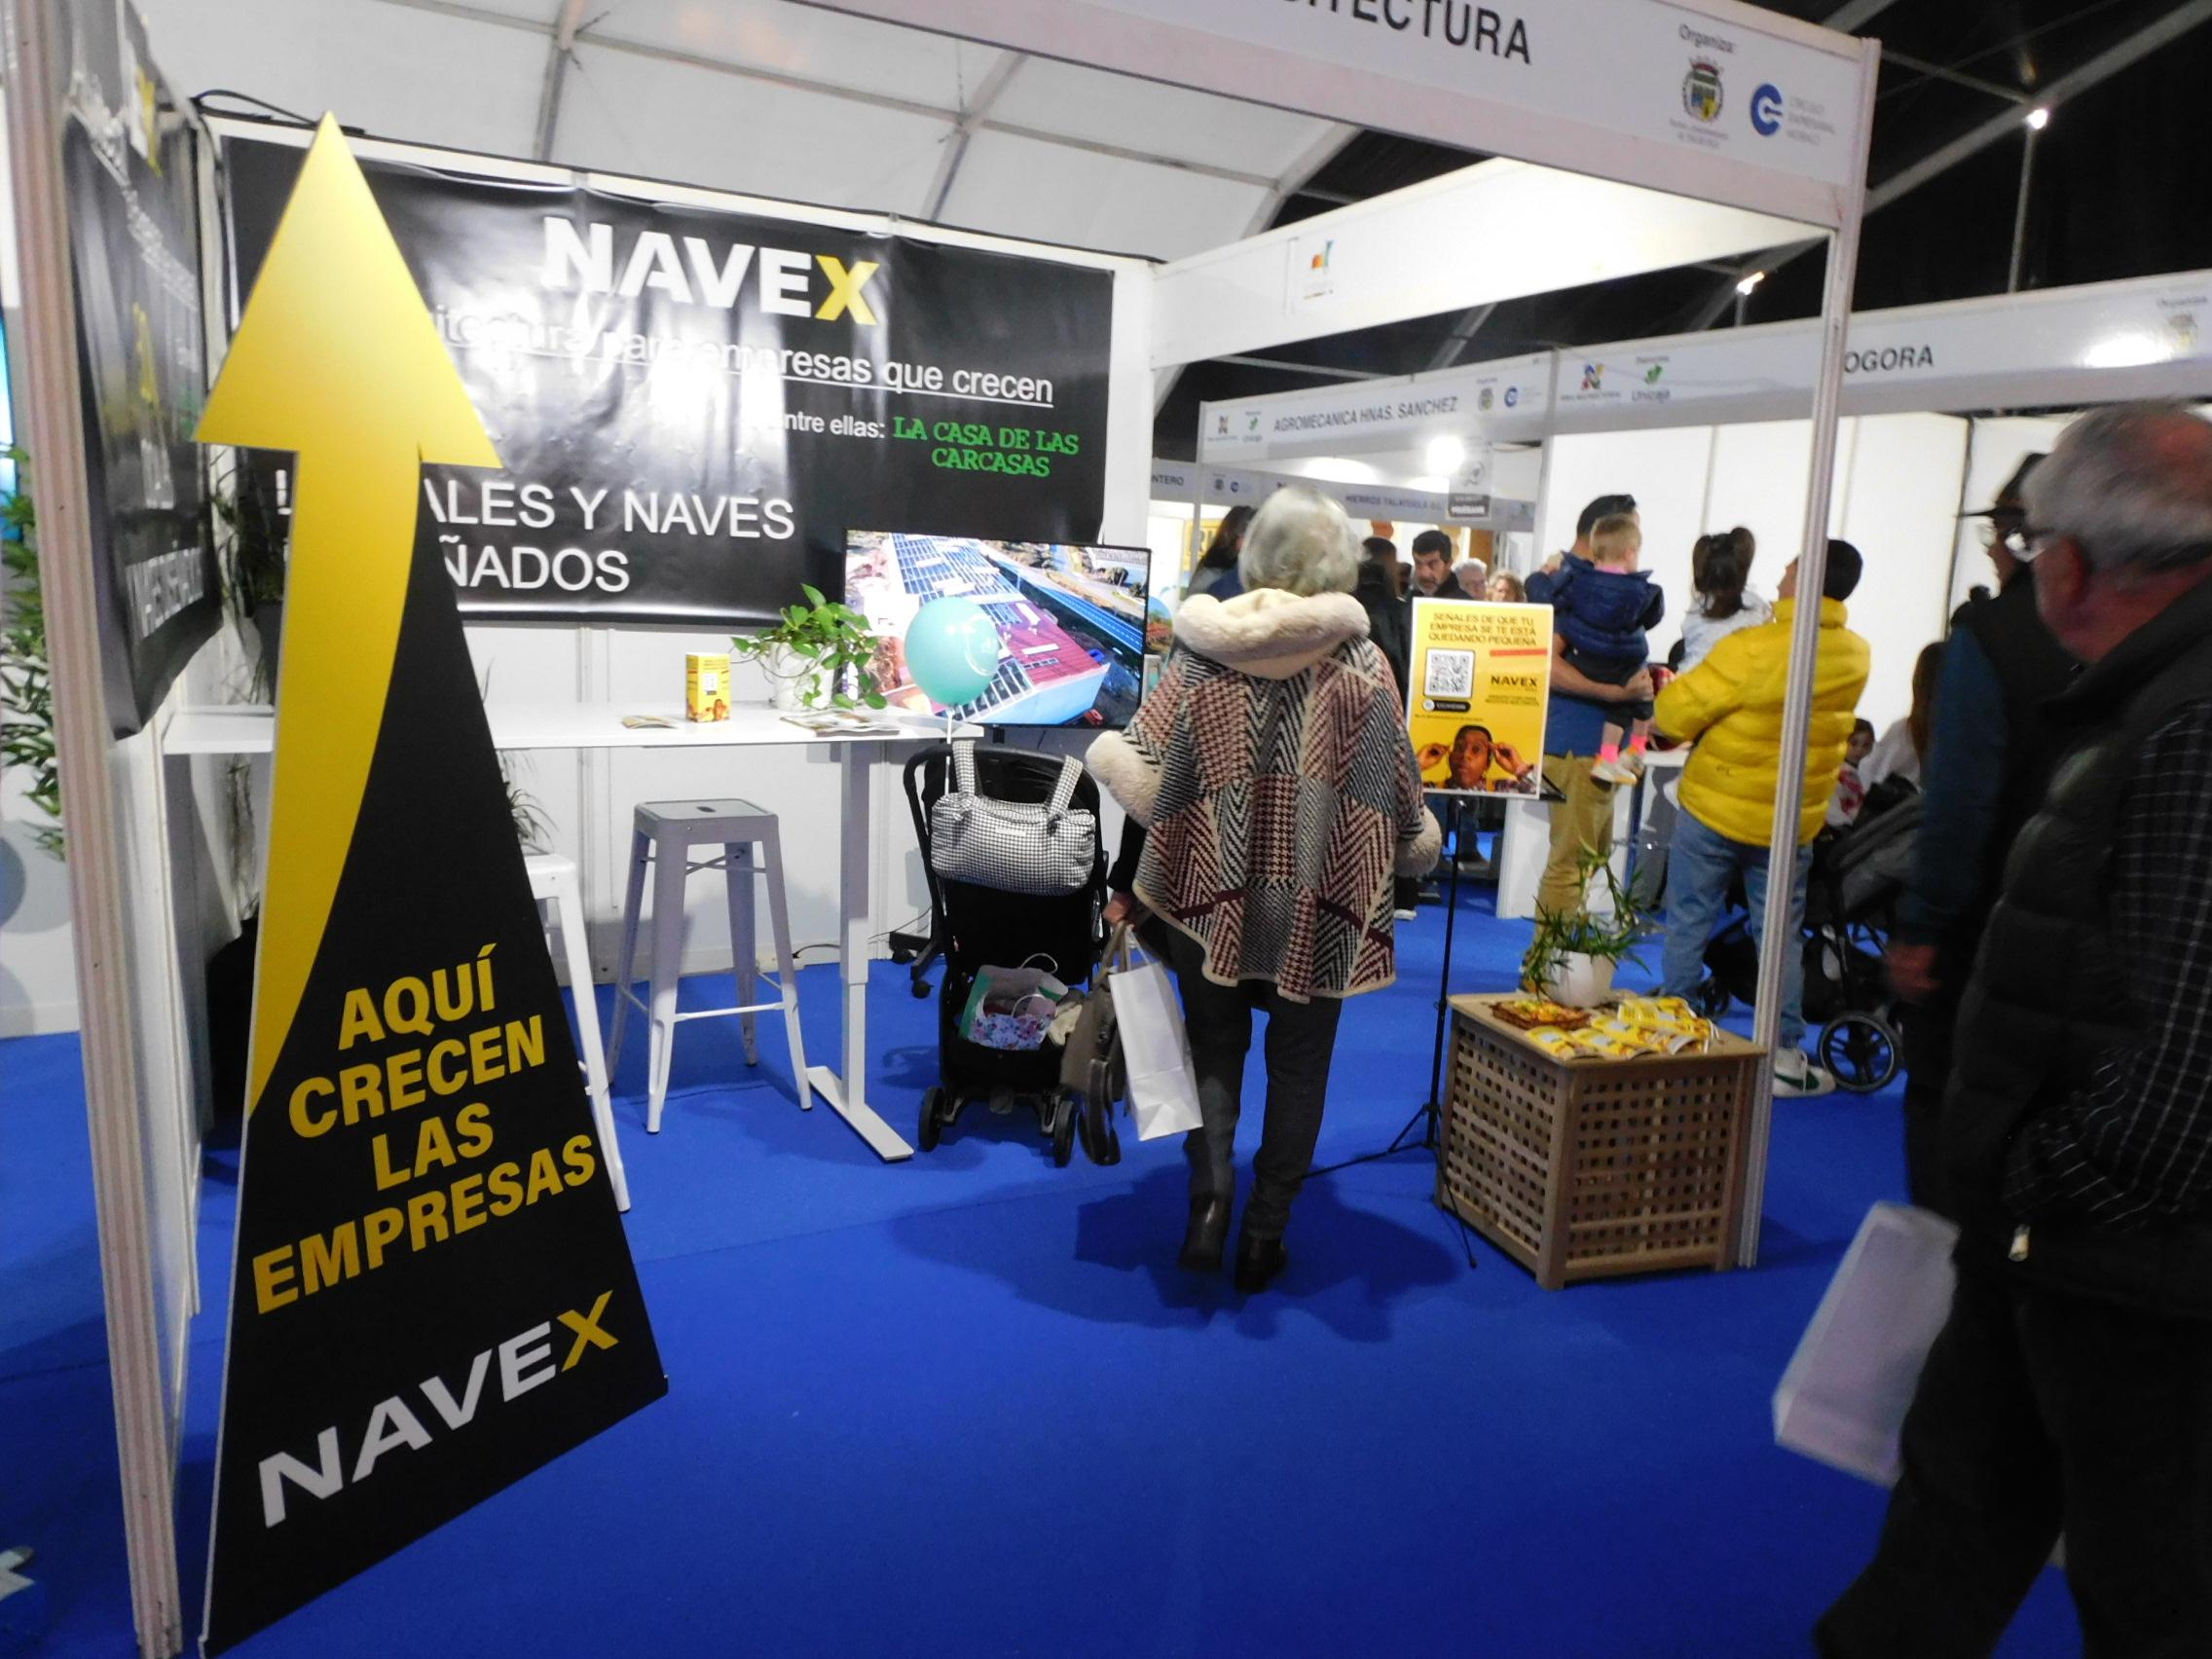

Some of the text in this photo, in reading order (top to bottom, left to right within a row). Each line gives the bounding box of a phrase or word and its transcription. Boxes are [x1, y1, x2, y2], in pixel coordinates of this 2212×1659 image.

[1283, 0, 1530, 65] ECTURA
[541, 216, 880, 326] NAVEX
[884, 359, 943, 393] que
[951, 368, 1053, 403] crecen
[1844, 344, 1934, 374] OGORA
[777, 411, 1080, 455] ntre ellas: LA CASA DE LAS
[1272, 409, 1357, 433] AGROMECANICA
[1397, 395, 1458, 420] SANCHEZ
[931, 448, 1051, 477] CARCASAS
[570, 487, 608, 531] Y
[623, 490, 796, 540] NAVES
[1428, 632, 1487, 644] QUEDANDO
[1429, 622, 1478, 633] EMPRESA
[1480, 625, 1492, 634] SE
[1496, 625, 1507, 635] TE
[1481, 614, 1493, 624] DE
[1497, 615, 1518, 625] QUE
[1521, 616, 1534, 626] TU
[1491, 675, 1537, 687] NAVEX
[338, 942, 497, 1051] AQUÍ
[288, 1014, 546, 1138] CRECEN
[372, 1102, 494, 1192] LAS
[252, 1134, 596, 1314] EMPRESAS
[258, 1289, 620, 1530] NAVEX
